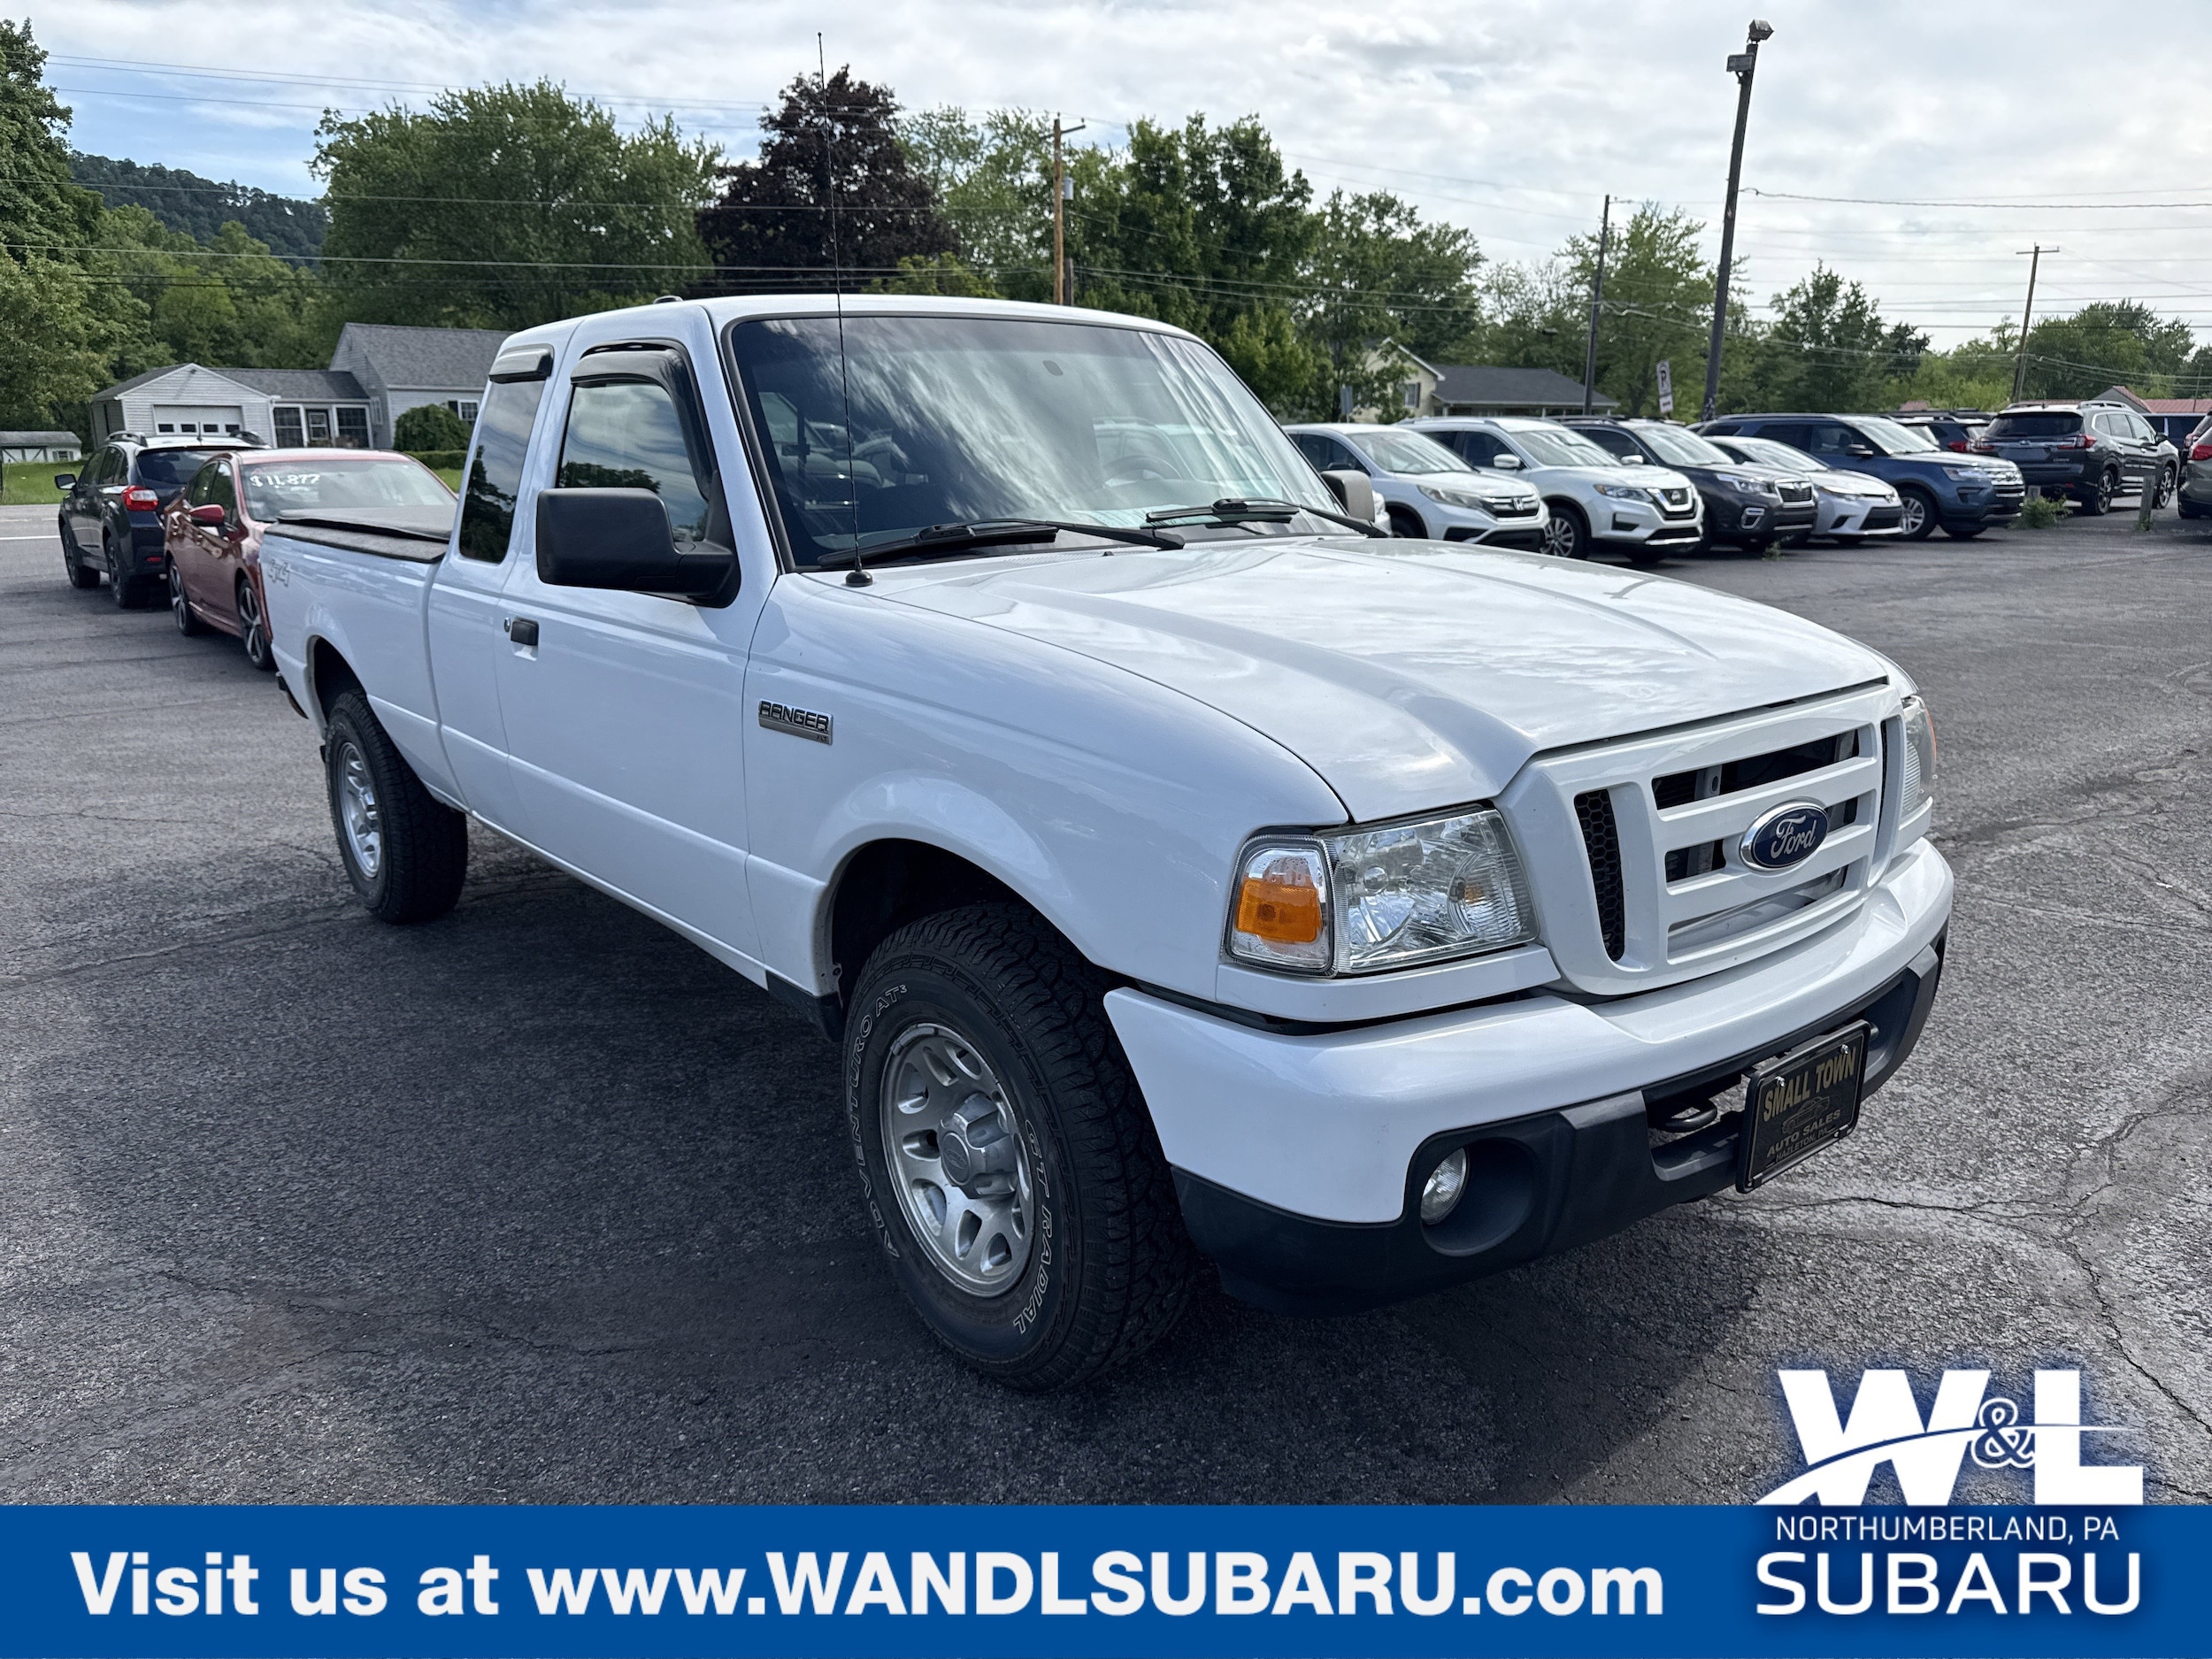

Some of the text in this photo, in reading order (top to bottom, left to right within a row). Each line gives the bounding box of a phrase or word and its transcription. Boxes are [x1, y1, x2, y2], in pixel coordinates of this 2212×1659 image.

[759, 700, 829, 732] RANGER
[1770, 814, 1817, 859] Ford
[1763, 1046, 1856, 1122] SMALL TOWN
[849, 1014, 899, 1261] ADVENTURO
[1766, 1109, 1840, 1158] AUTO SALES
[1013, 1119, 1053, 1335] GT RADIAL
